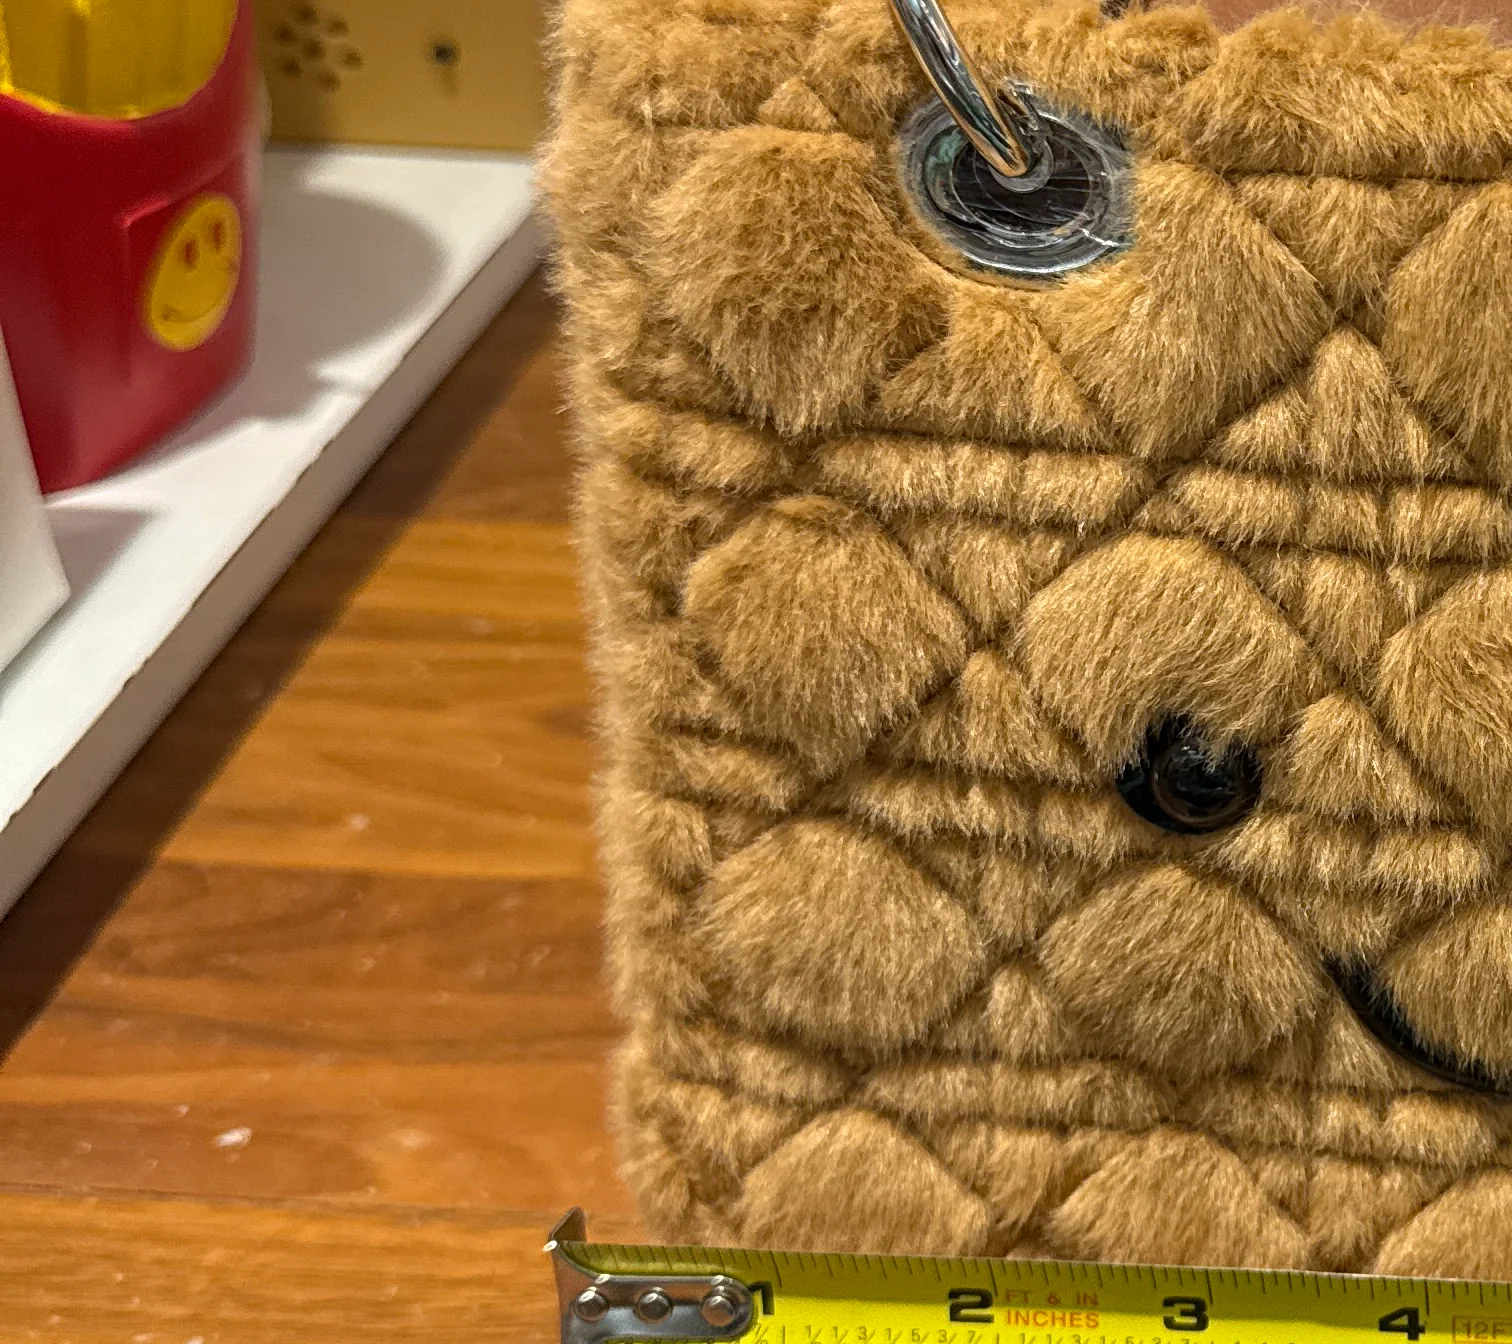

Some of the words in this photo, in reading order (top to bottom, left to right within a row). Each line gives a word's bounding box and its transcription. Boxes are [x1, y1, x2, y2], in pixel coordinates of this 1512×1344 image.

[1006, 1289, 1030, 1304] FT
[1077, 1292, 1099, 1305] IN
[750, 1282, 775, 1316] 1
[949, 1288, 993, 1324] 2
[1163, 1296, 1209, 1331] 3
[1379, 1307, 1425, 1341] 4
[1007, 1309, 1099, 1328] INCHES
